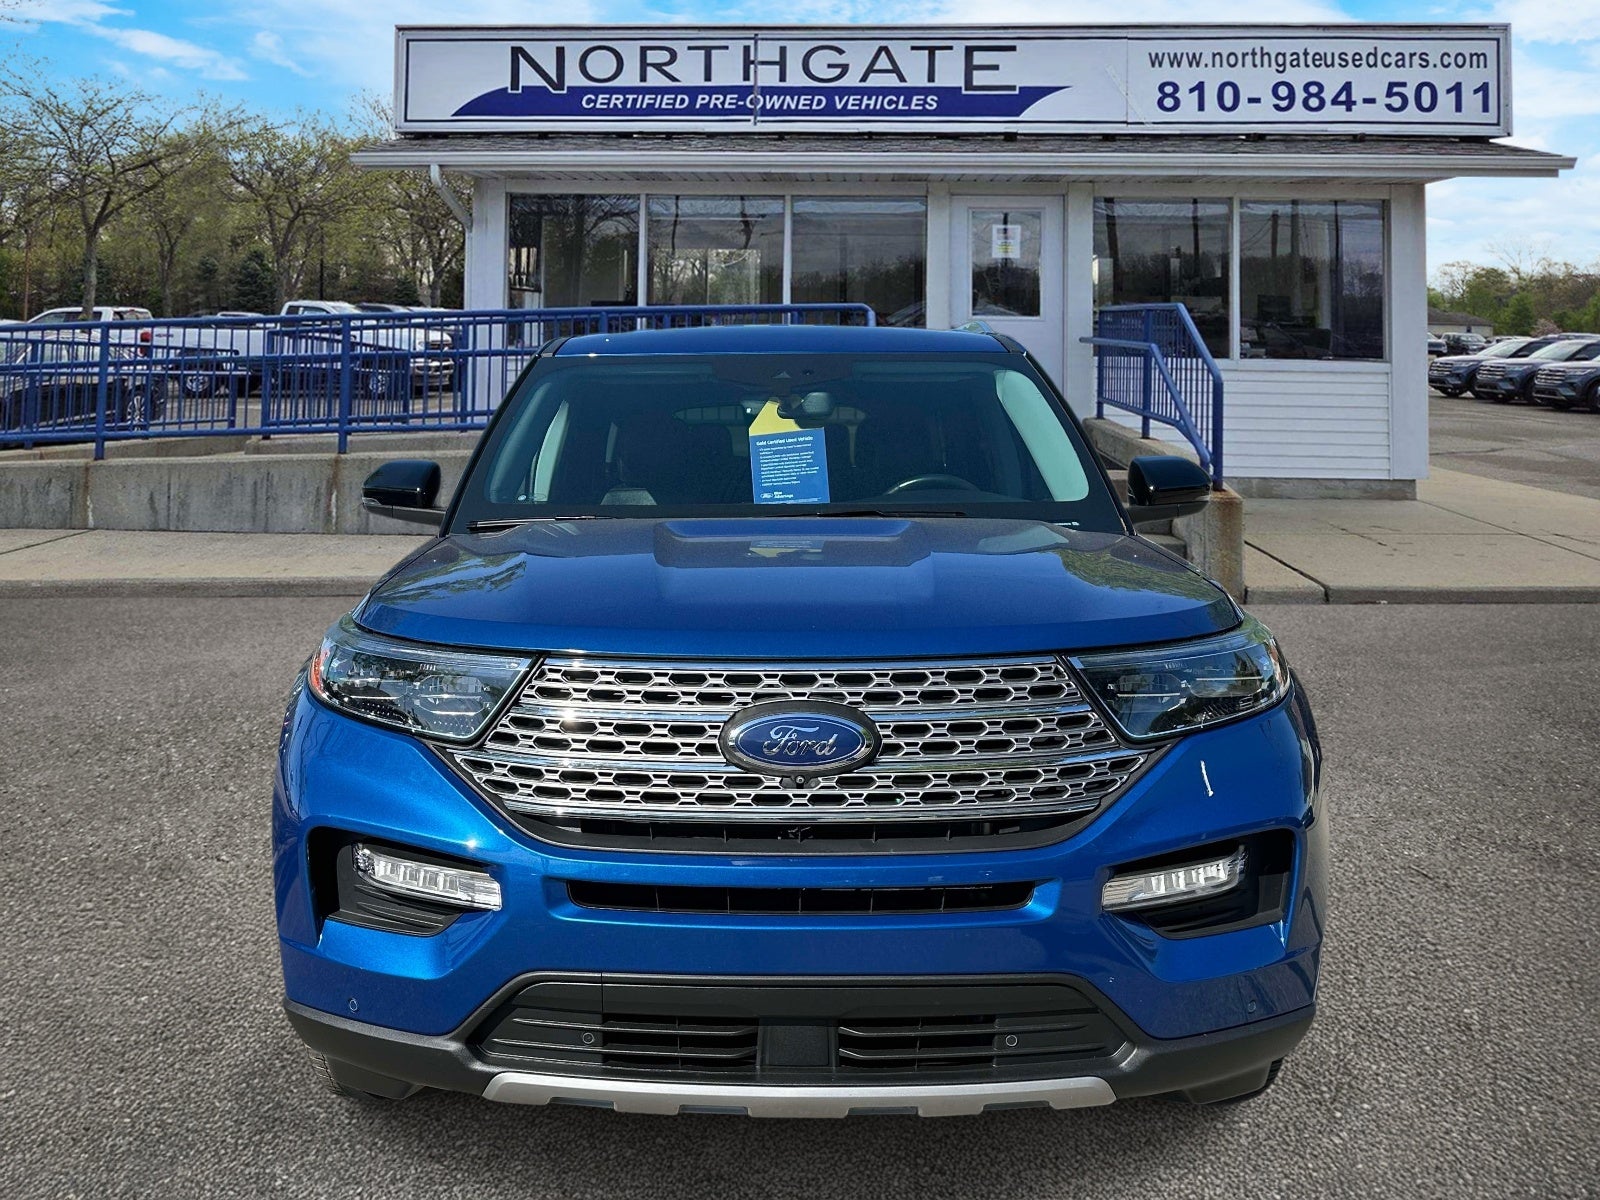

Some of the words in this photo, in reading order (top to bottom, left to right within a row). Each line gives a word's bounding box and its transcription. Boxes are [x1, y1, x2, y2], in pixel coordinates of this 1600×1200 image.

[510, 45, 1017, 91] NORTHGATE
[1148, 47, 1488, 73] www.northgateusedcars.com
[581, 94, 689, 109] CERTIFIED
[695, 94, 826, 110] PRE-OWNED
[834, 95, 938, 110] VEHICLES
[1156, 80, 1491, 112] 810-984-5011
[763, 725, 838, 756] Ford
